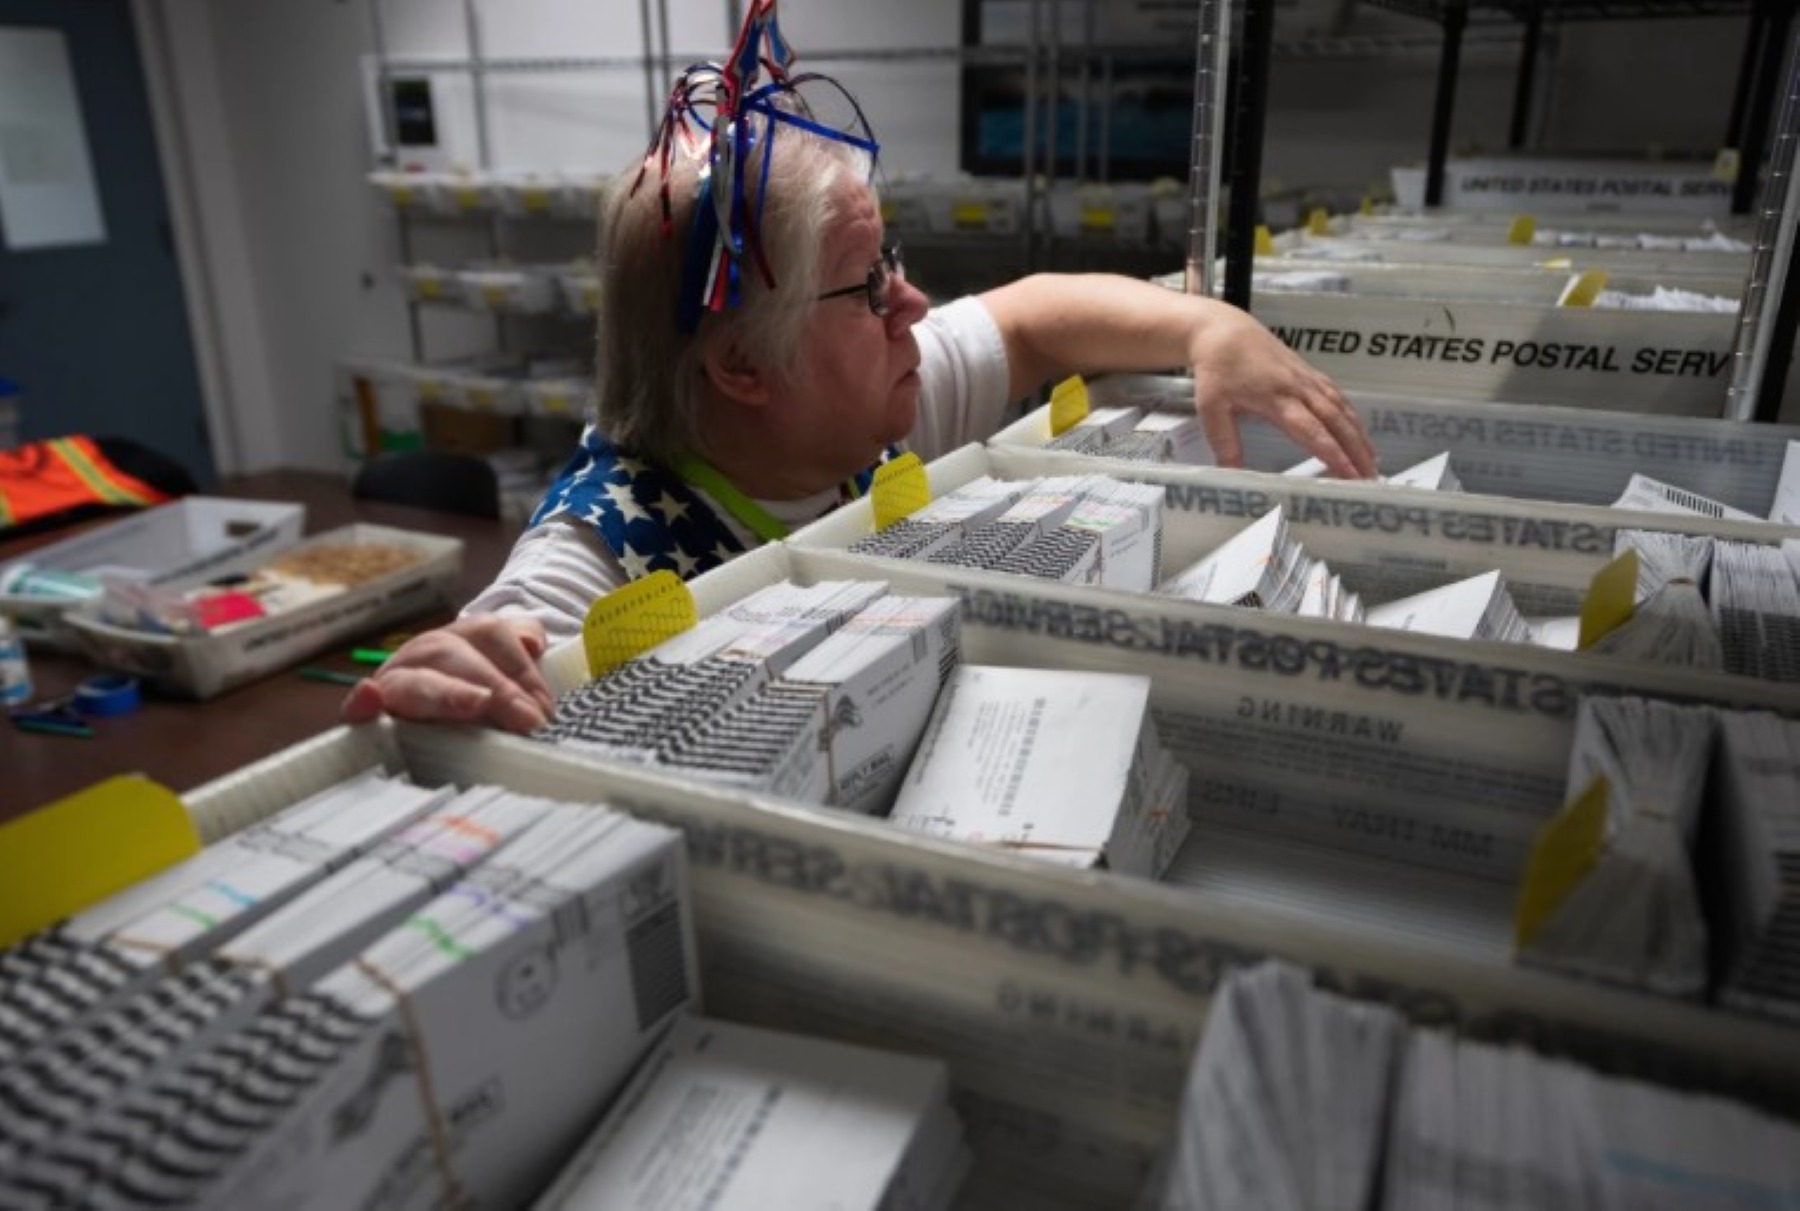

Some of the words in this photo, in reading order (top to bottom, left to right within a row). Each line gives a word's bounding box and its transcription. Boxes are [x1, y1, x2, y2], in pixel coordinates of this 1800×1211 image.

[1460, 175, 1526, 194] UNITED
[1527, 176, 1597, 196] STATES
[1600, 178, 1674, 197] POSTAL
[1367, 332, 1485, 364] STATES
[1490, 339, 1620, 373] POSTAL
[1631, 347, 1732, 378] SERV
